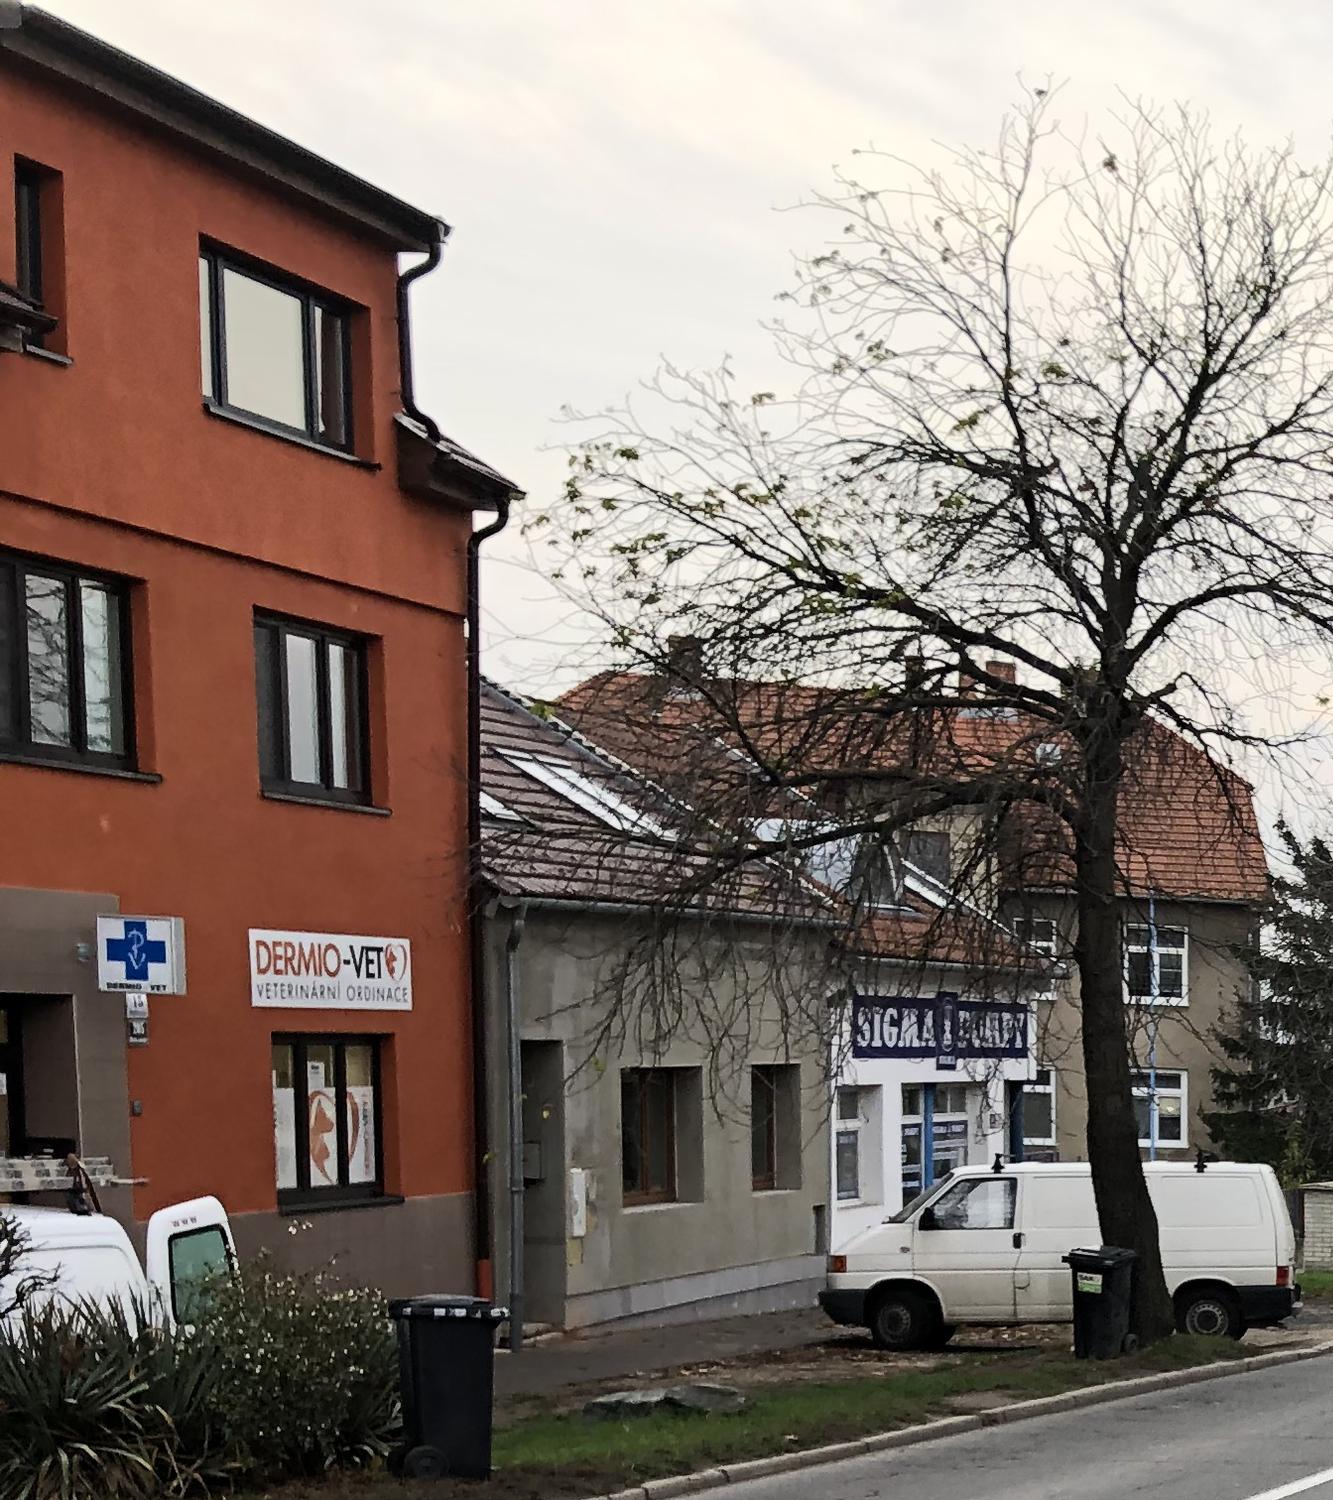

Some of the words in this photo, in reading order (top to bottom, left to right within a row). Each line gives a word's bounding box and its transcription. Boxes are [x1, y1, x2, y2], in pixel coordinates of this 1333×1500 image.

[256, 980, 341, 1000] VETERINÁRNÍ
[346, 985, 409, 1003] ORDINACE
[856, 1006, 936, 1048] SIGMA
